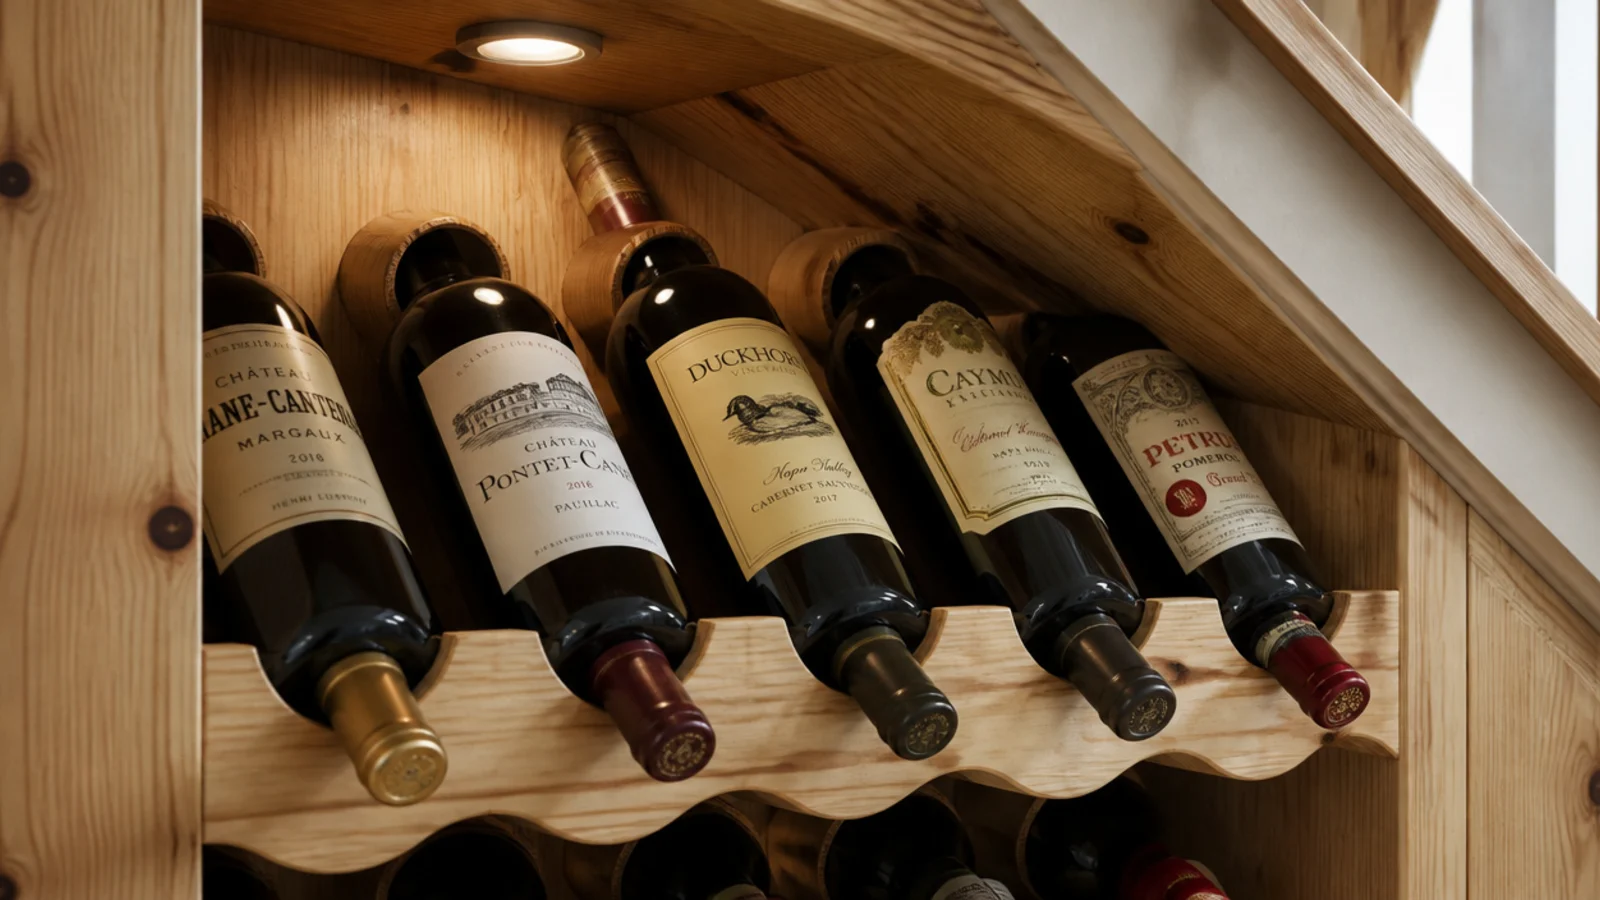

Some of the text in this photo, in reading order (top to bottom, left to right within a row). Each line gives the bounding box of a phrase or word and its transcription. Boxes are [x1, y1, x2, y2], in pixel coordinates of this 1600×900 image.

[215, 366, 312, 388] CHÂTEAU
[237, 428, 347, 451] MARGAUX
[524, 436, 597, 453] CHÂTEAU
[566, 480, 594, 491] 2016
[554, 499, 620, 513] PAUILLAC
[751, 481, 814, 514] CABERNET
[813, 494, 838, 504] 2017
